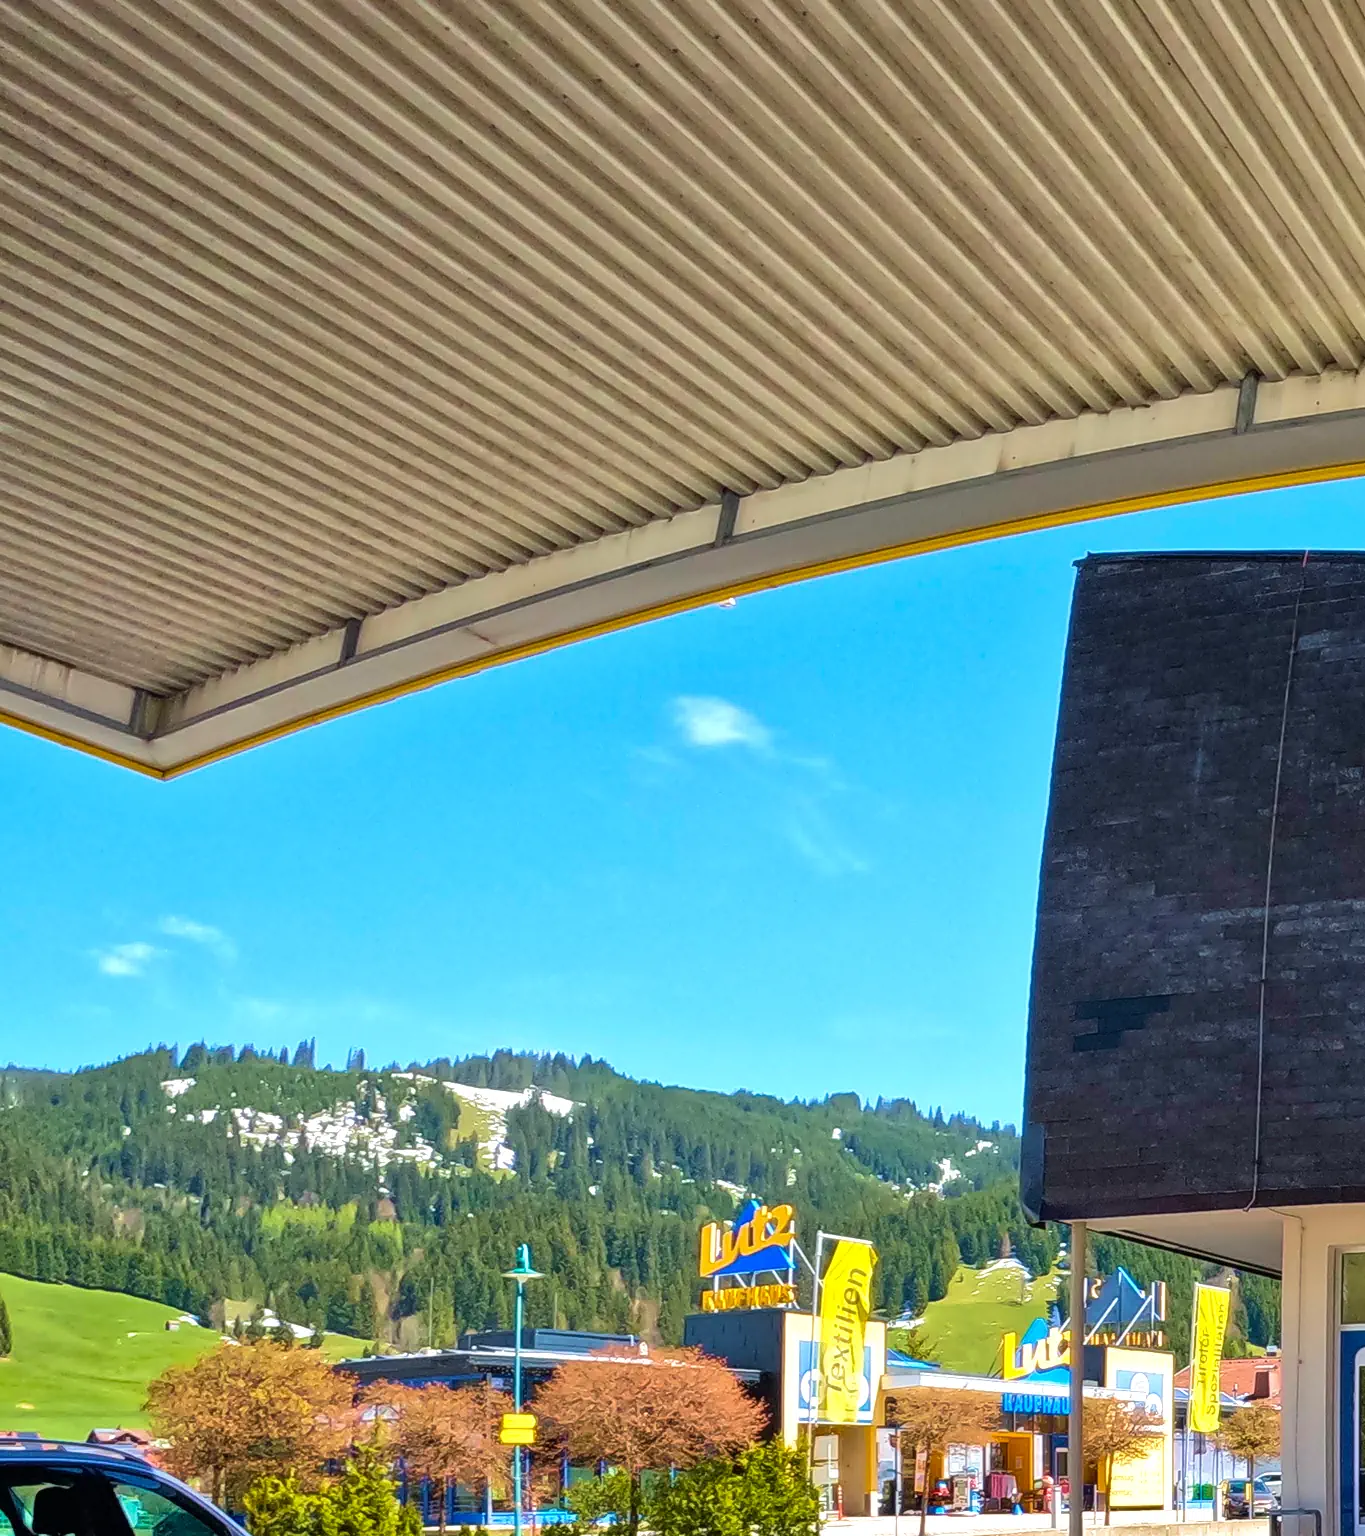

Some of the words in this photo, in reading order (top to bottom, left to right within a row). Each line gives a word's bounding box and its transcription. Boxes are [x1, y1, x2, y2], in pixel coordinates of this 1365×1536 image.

[700, 1204, 796, 1278] Lutz
[702, 1284, 798, 1312] KAUFHAUS
[824, 1267, 867, 1392] Textilien
